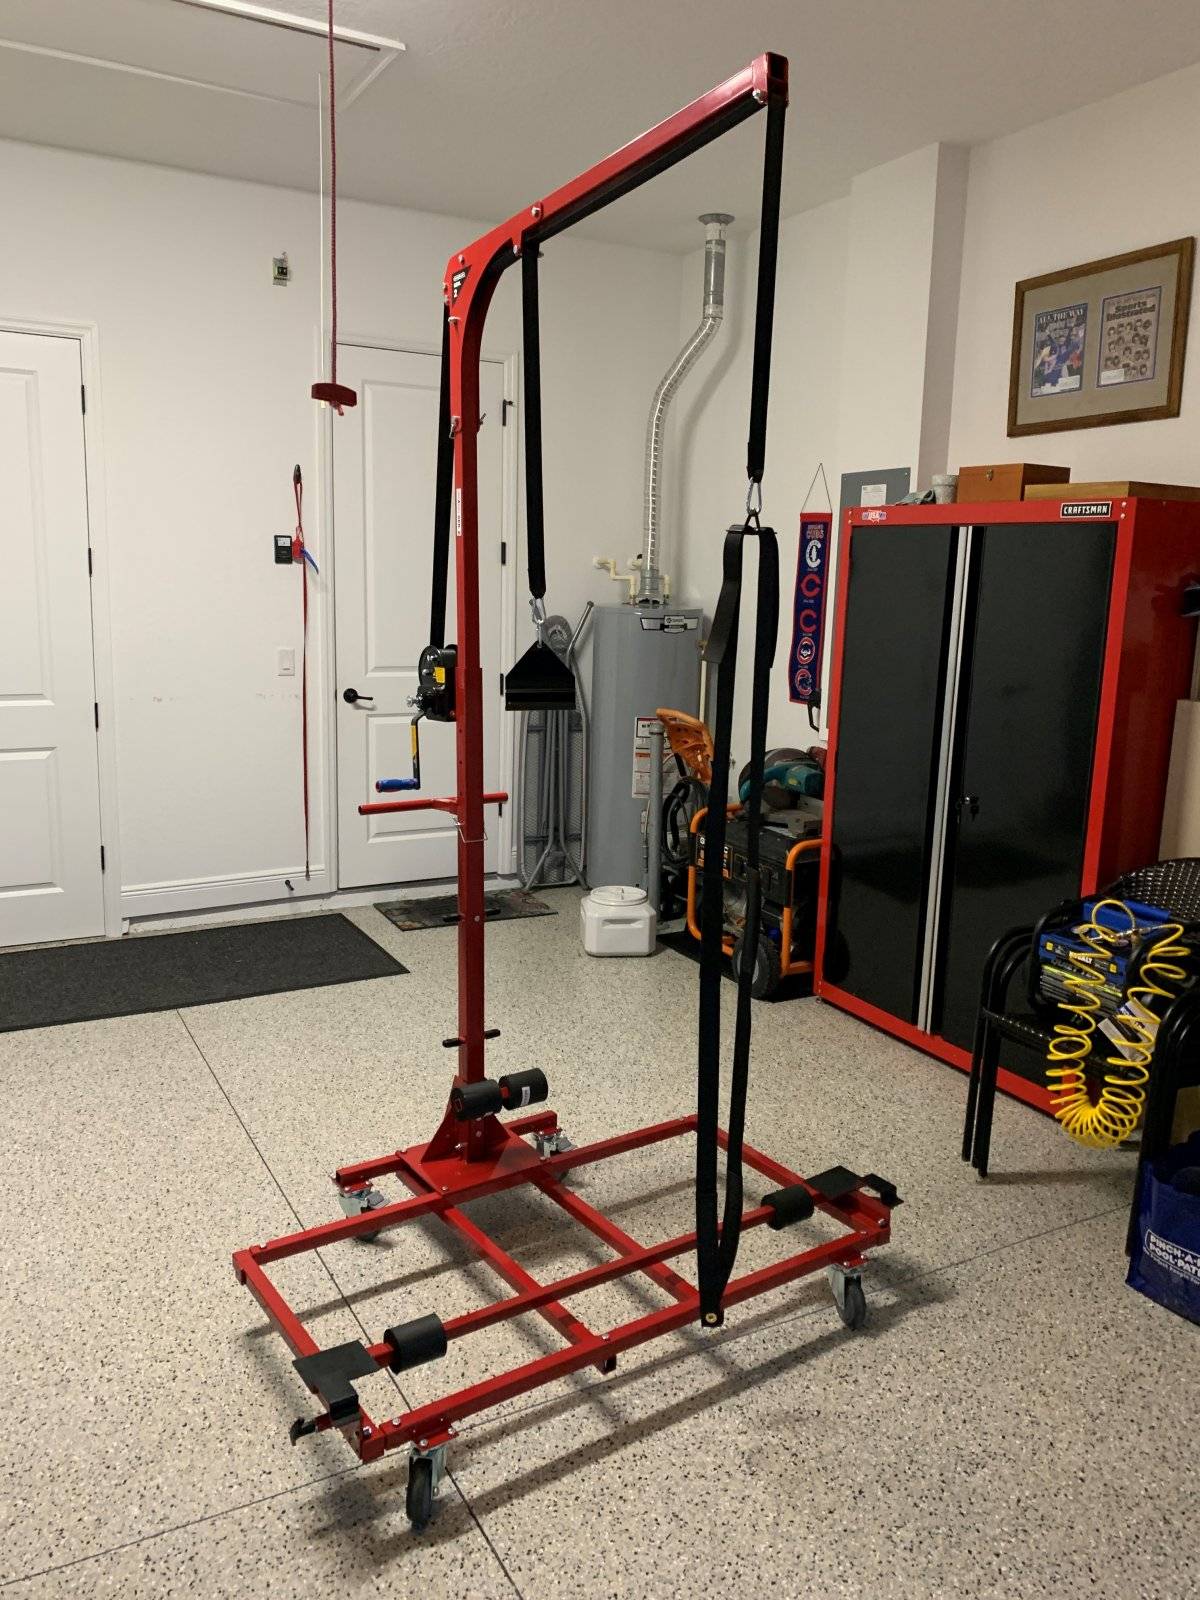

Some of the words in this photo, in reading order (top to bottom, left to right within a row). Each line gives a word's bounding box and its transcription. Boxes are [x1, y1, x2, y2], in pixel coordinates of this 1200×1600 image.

[1106, 304, 1156, 322] Illustrated
[1115, 300, 1147, 313] Sports
[1063, 504, 1108, 515] CRAFTSMAN
